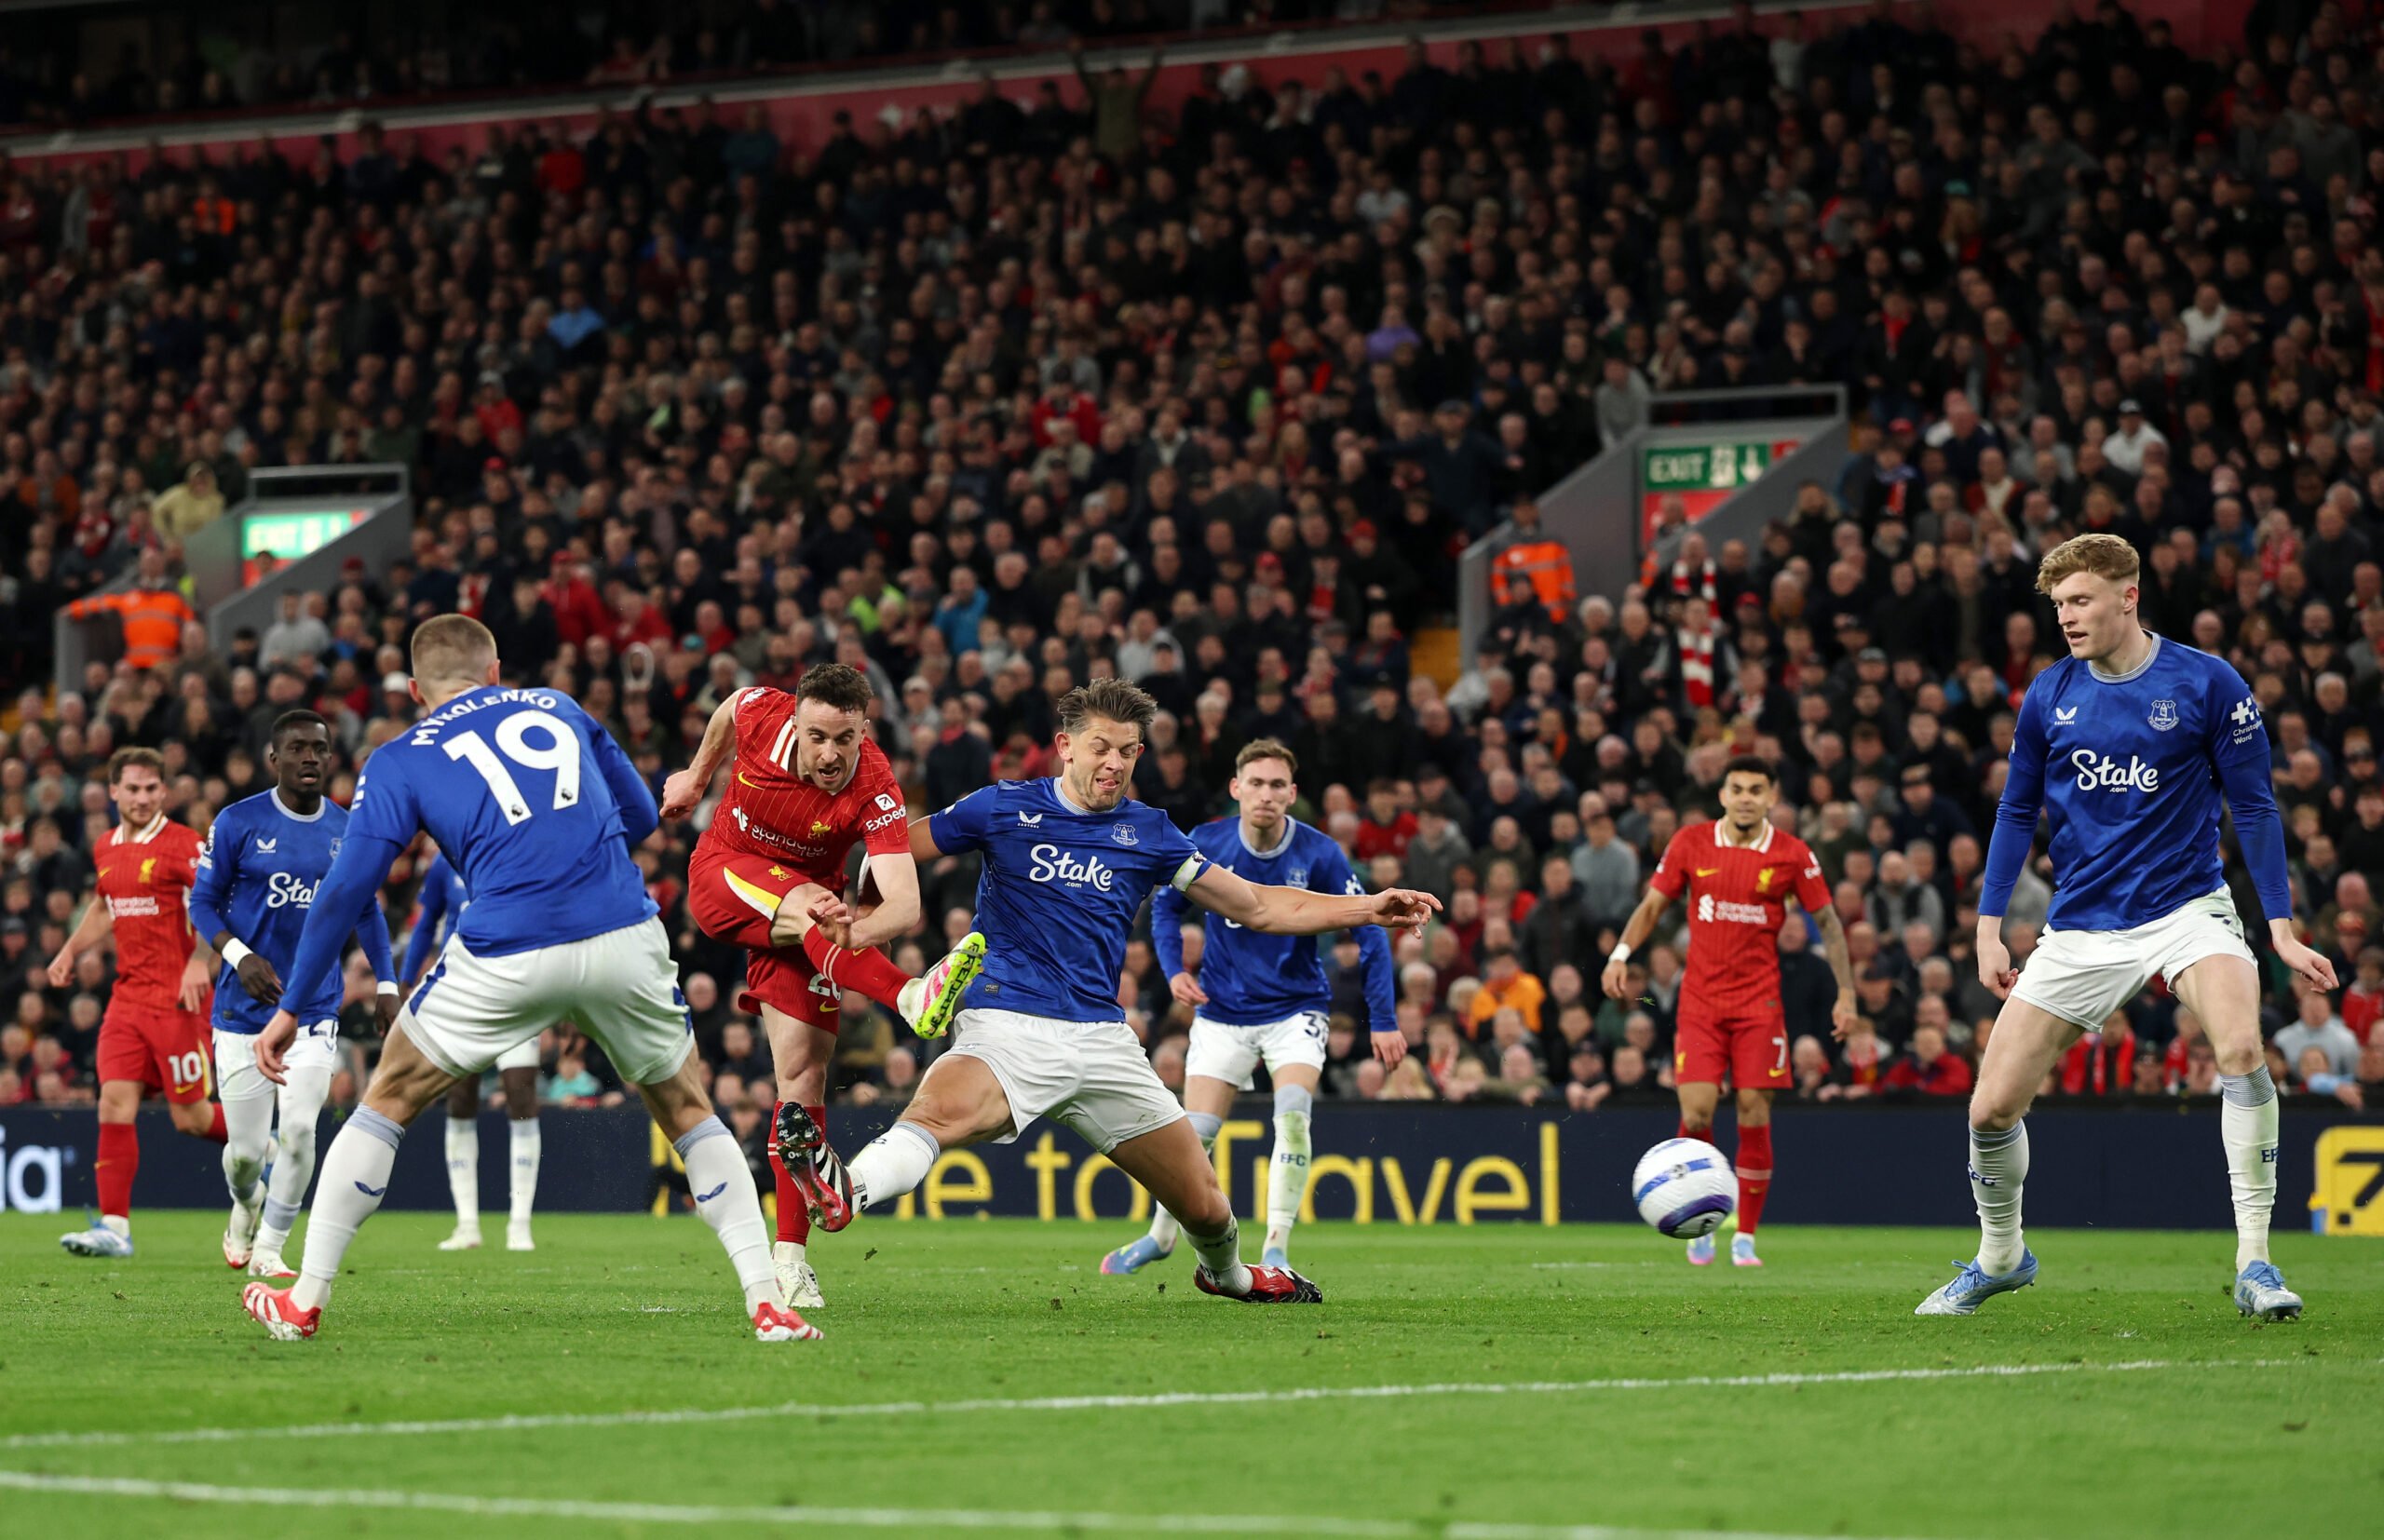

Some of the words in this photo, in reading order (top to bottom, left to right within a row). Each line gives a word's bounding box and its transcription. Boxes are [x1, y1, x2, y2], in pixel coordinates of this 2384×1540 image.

[1649, 453, 1705, 483] EXIT
[411, 689, 557, 746] MYKOLENKO
[2233, 732, 2253, 745] Ward
[441, 709, 580, 826] 19
[2071, 749, 2159, 792] Stake
[1029, 844, 1113, 892] Stake
[168, 1050, 202, 1085] 10
[1771, 1036, 1785, 1069] 7
[1280, 1153, 1307, 1167] EFC
[2261, 1148, 2279, 1163] EF
[1025, 1129, 1149, 1223] to
